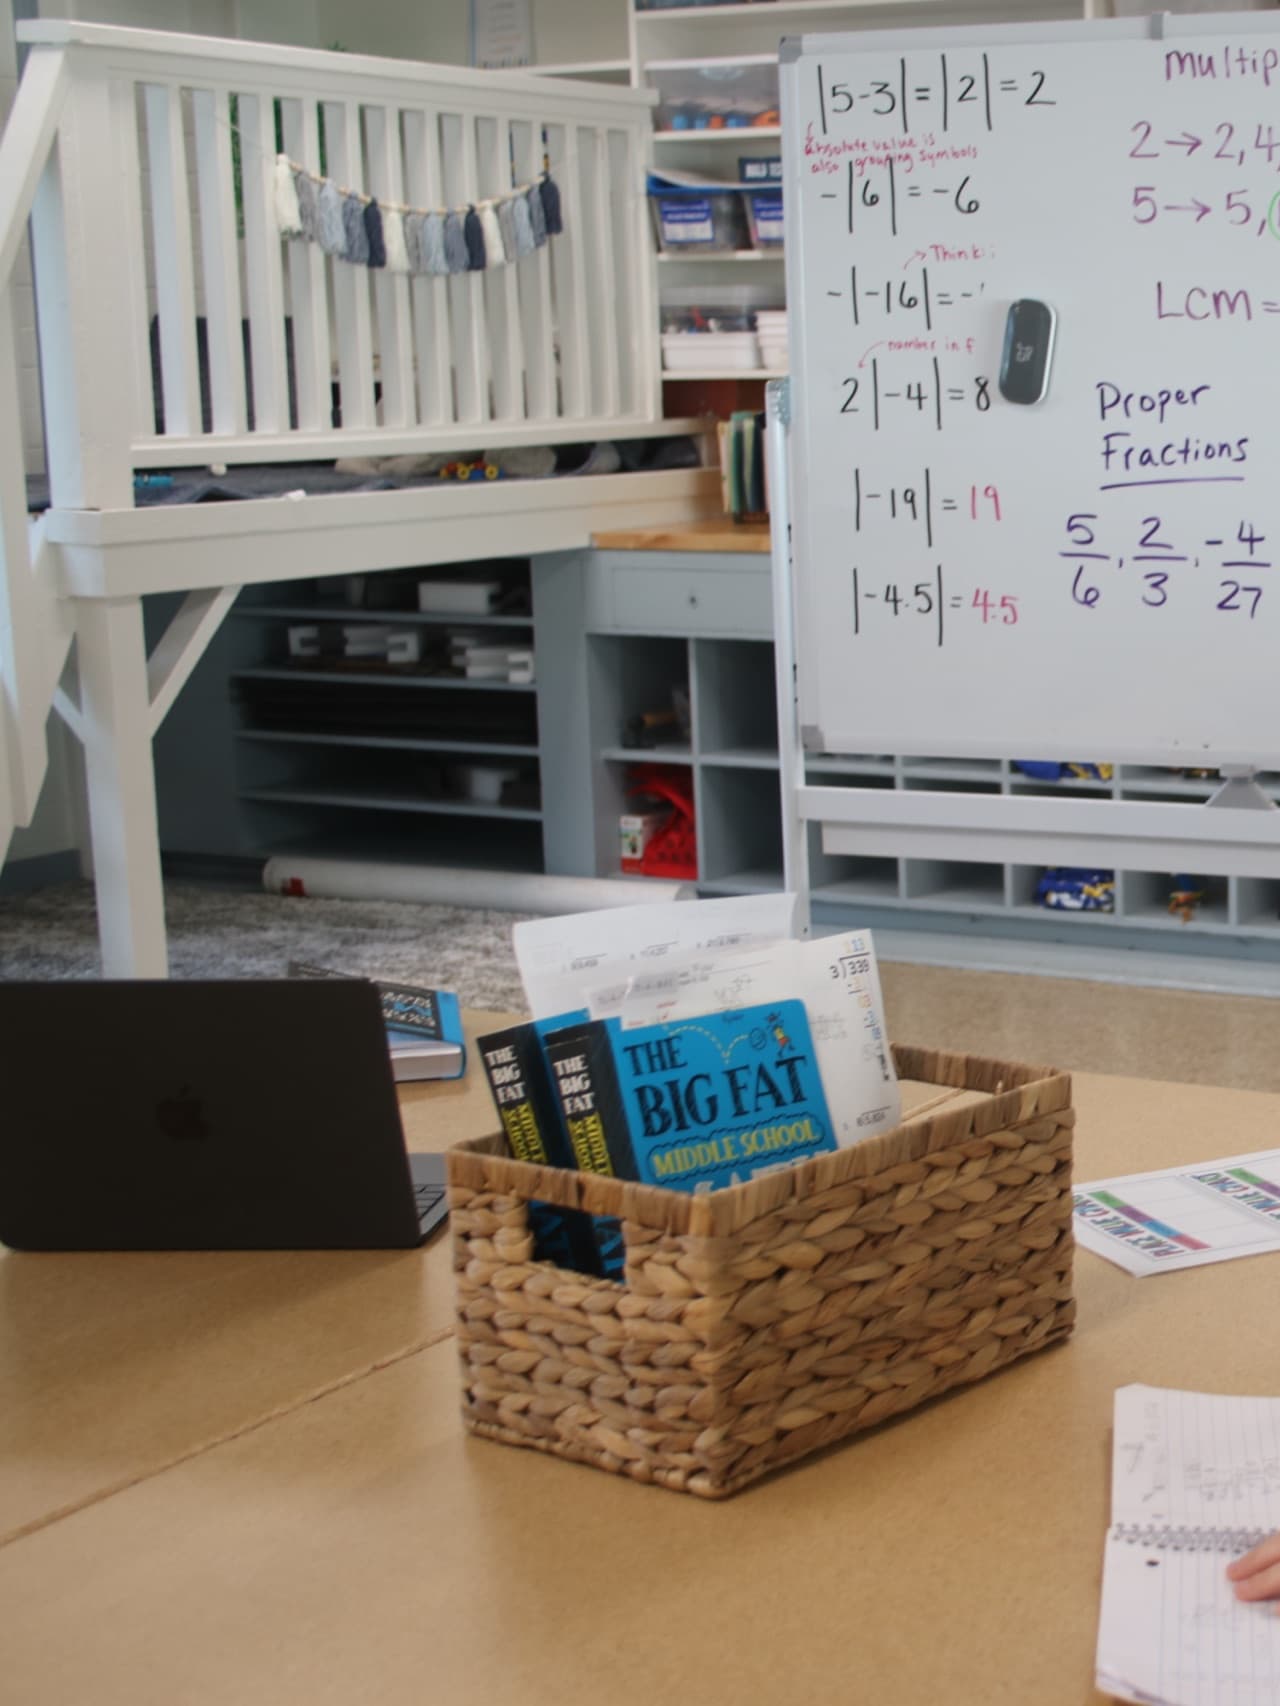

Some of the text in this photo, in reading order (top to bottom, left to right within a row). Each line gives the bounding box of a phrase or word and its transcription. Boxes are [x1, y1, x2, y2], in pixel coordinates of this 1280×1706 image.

[873, 137, 918, 151] value
[922, 133, 936, 148] is
[810, 159, 840, 174] also
[854, 152, 915, 177] grouping
[1096, 381, 1211, 423] Proper
[1101, 431, 1249, 471] Fractions
[484, 1044, 518, 1067] THE
[553, 1054, 588, 1077] THE
[623, 1035, 689, 1077] THE
[490, 1063, 522, 1086] BIG
[558, 1072, 592, 1097] BIG
[495, 1081, 526, 1105] FAT
[562, 1091, 596, 1116] FAT
[632, 1055, 808, 1138] BIG FAT
[652, 1134, 739, 1178] MIDDLE
[739, 1118, 819, 1158] SCHOOL
